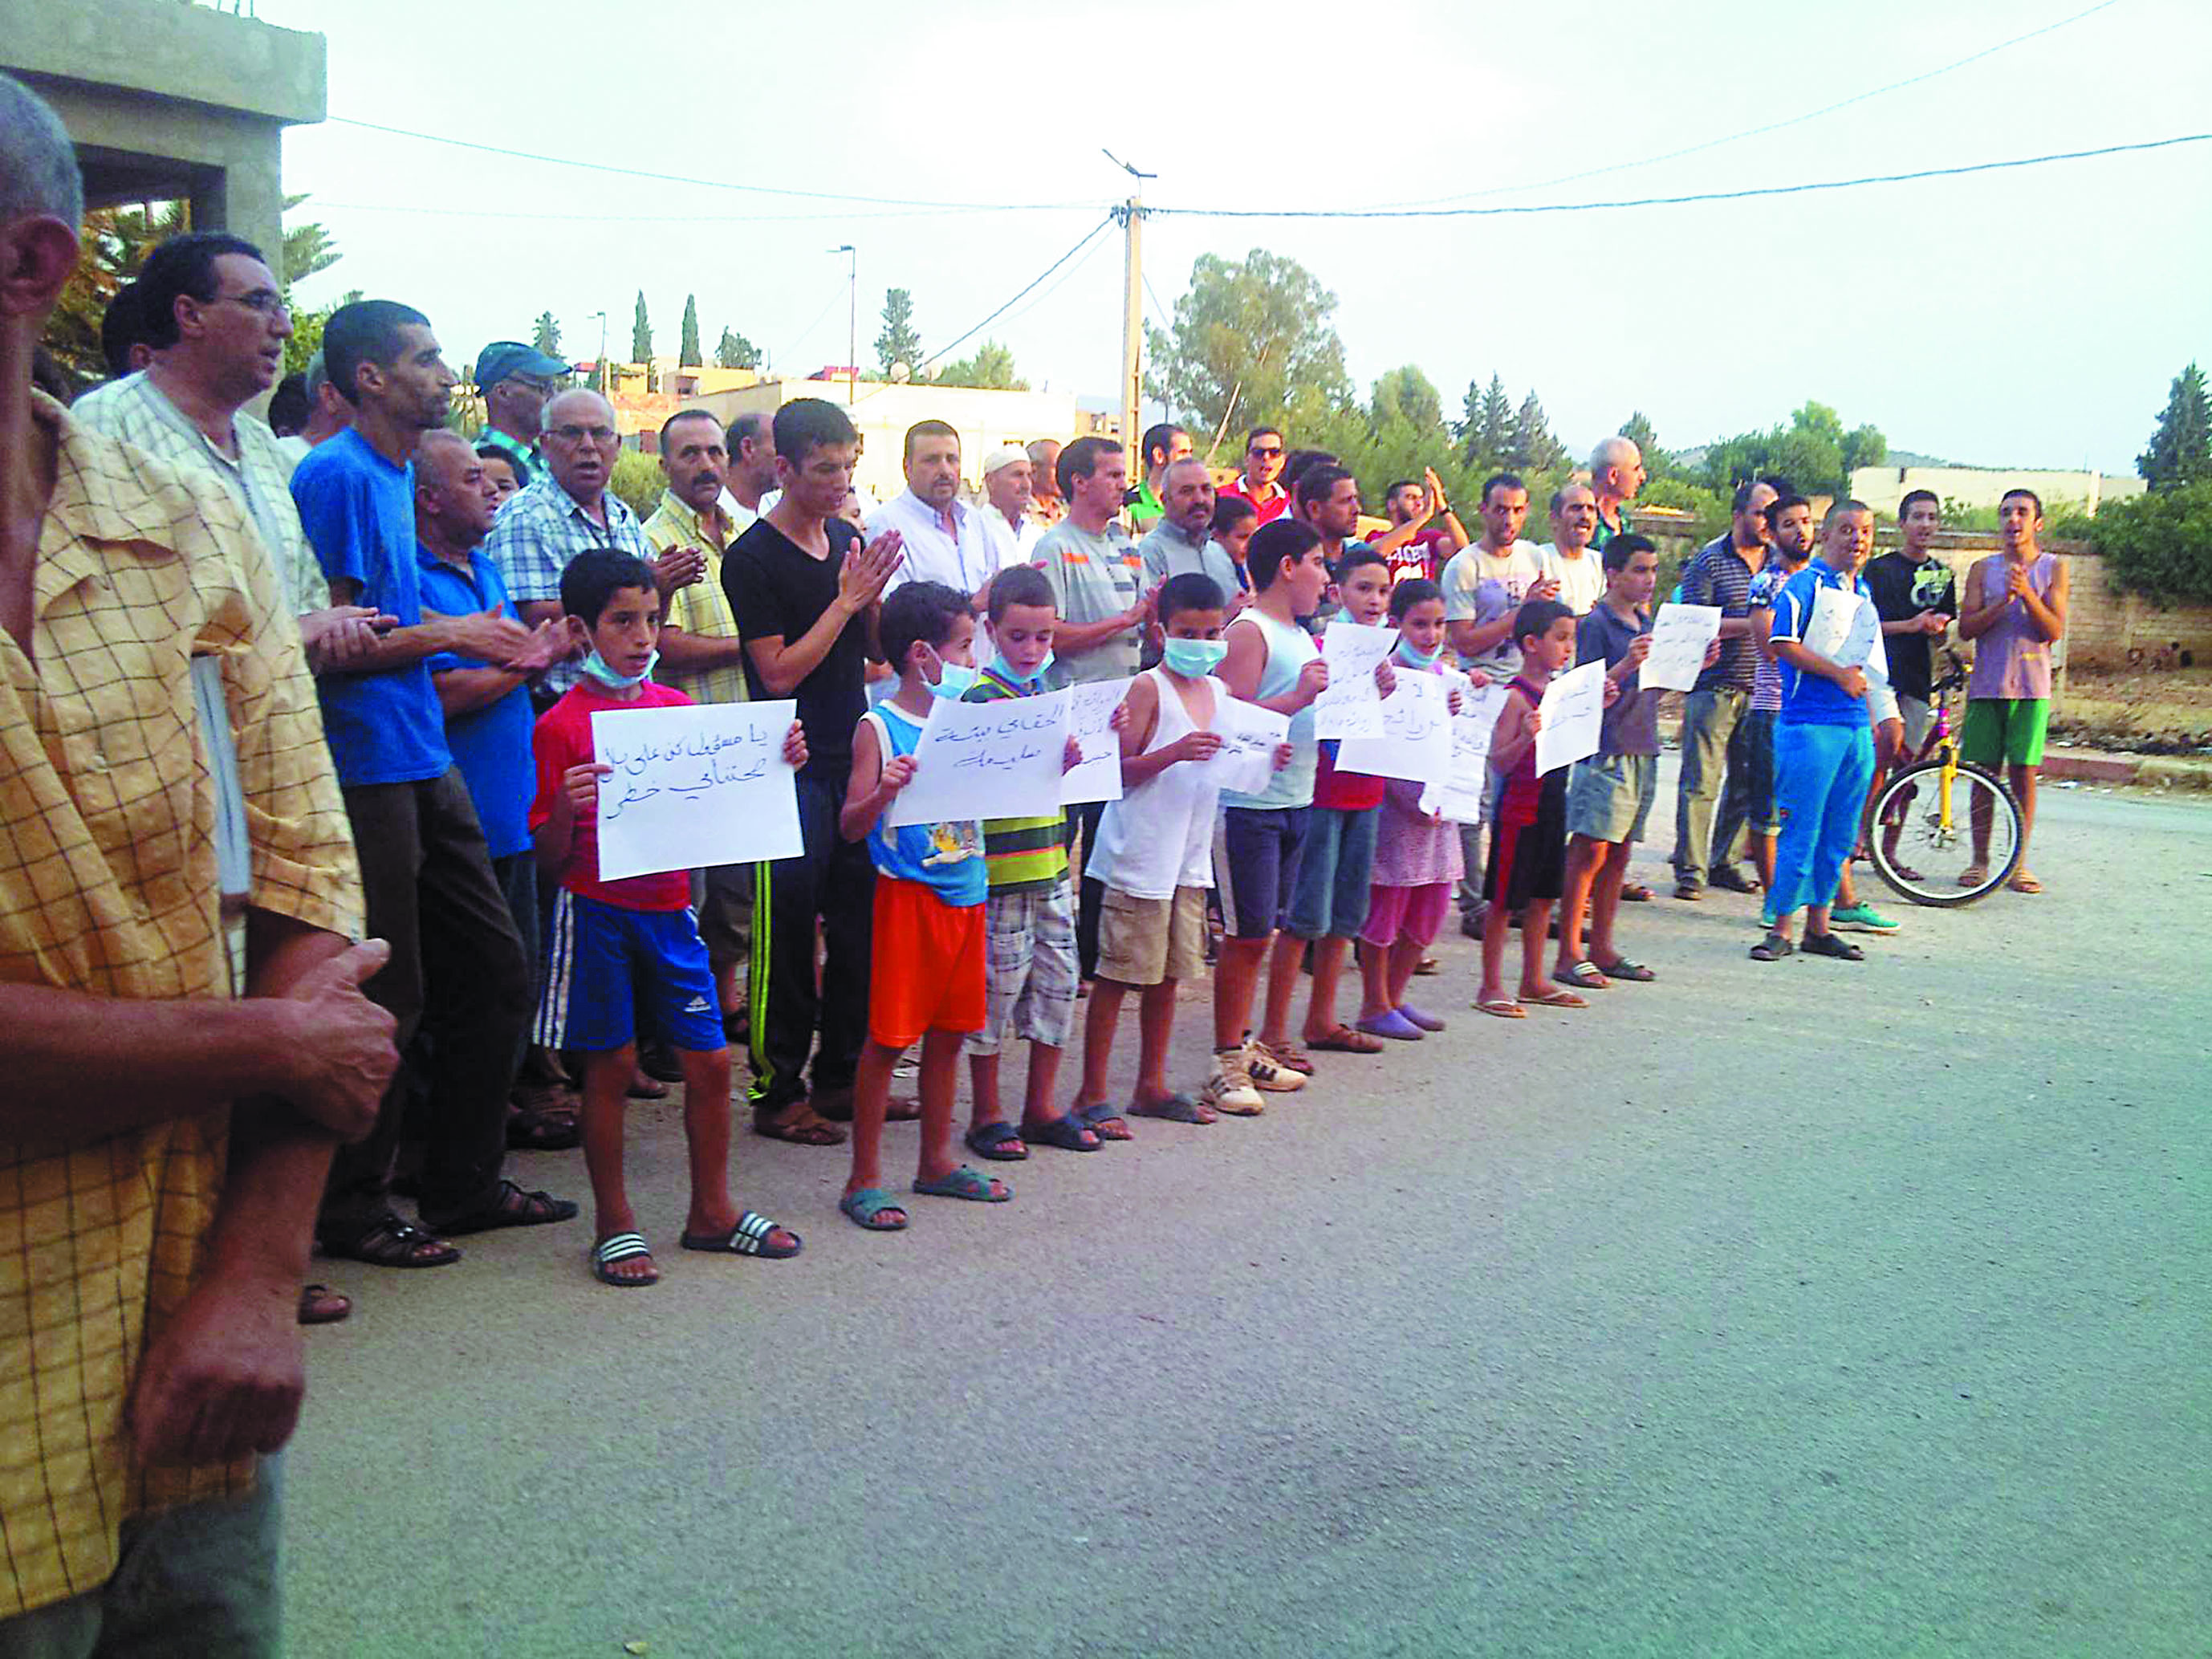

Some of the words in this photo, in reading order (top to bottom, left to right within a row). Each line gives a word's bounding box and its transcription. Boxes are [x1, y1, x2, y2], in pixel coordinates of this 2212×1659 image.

[749, 722, 768, 746] يا
[624, 743, 661, 777] على
[606, 780, 661, 820] خطر
[668, 771, 715, 800] في
